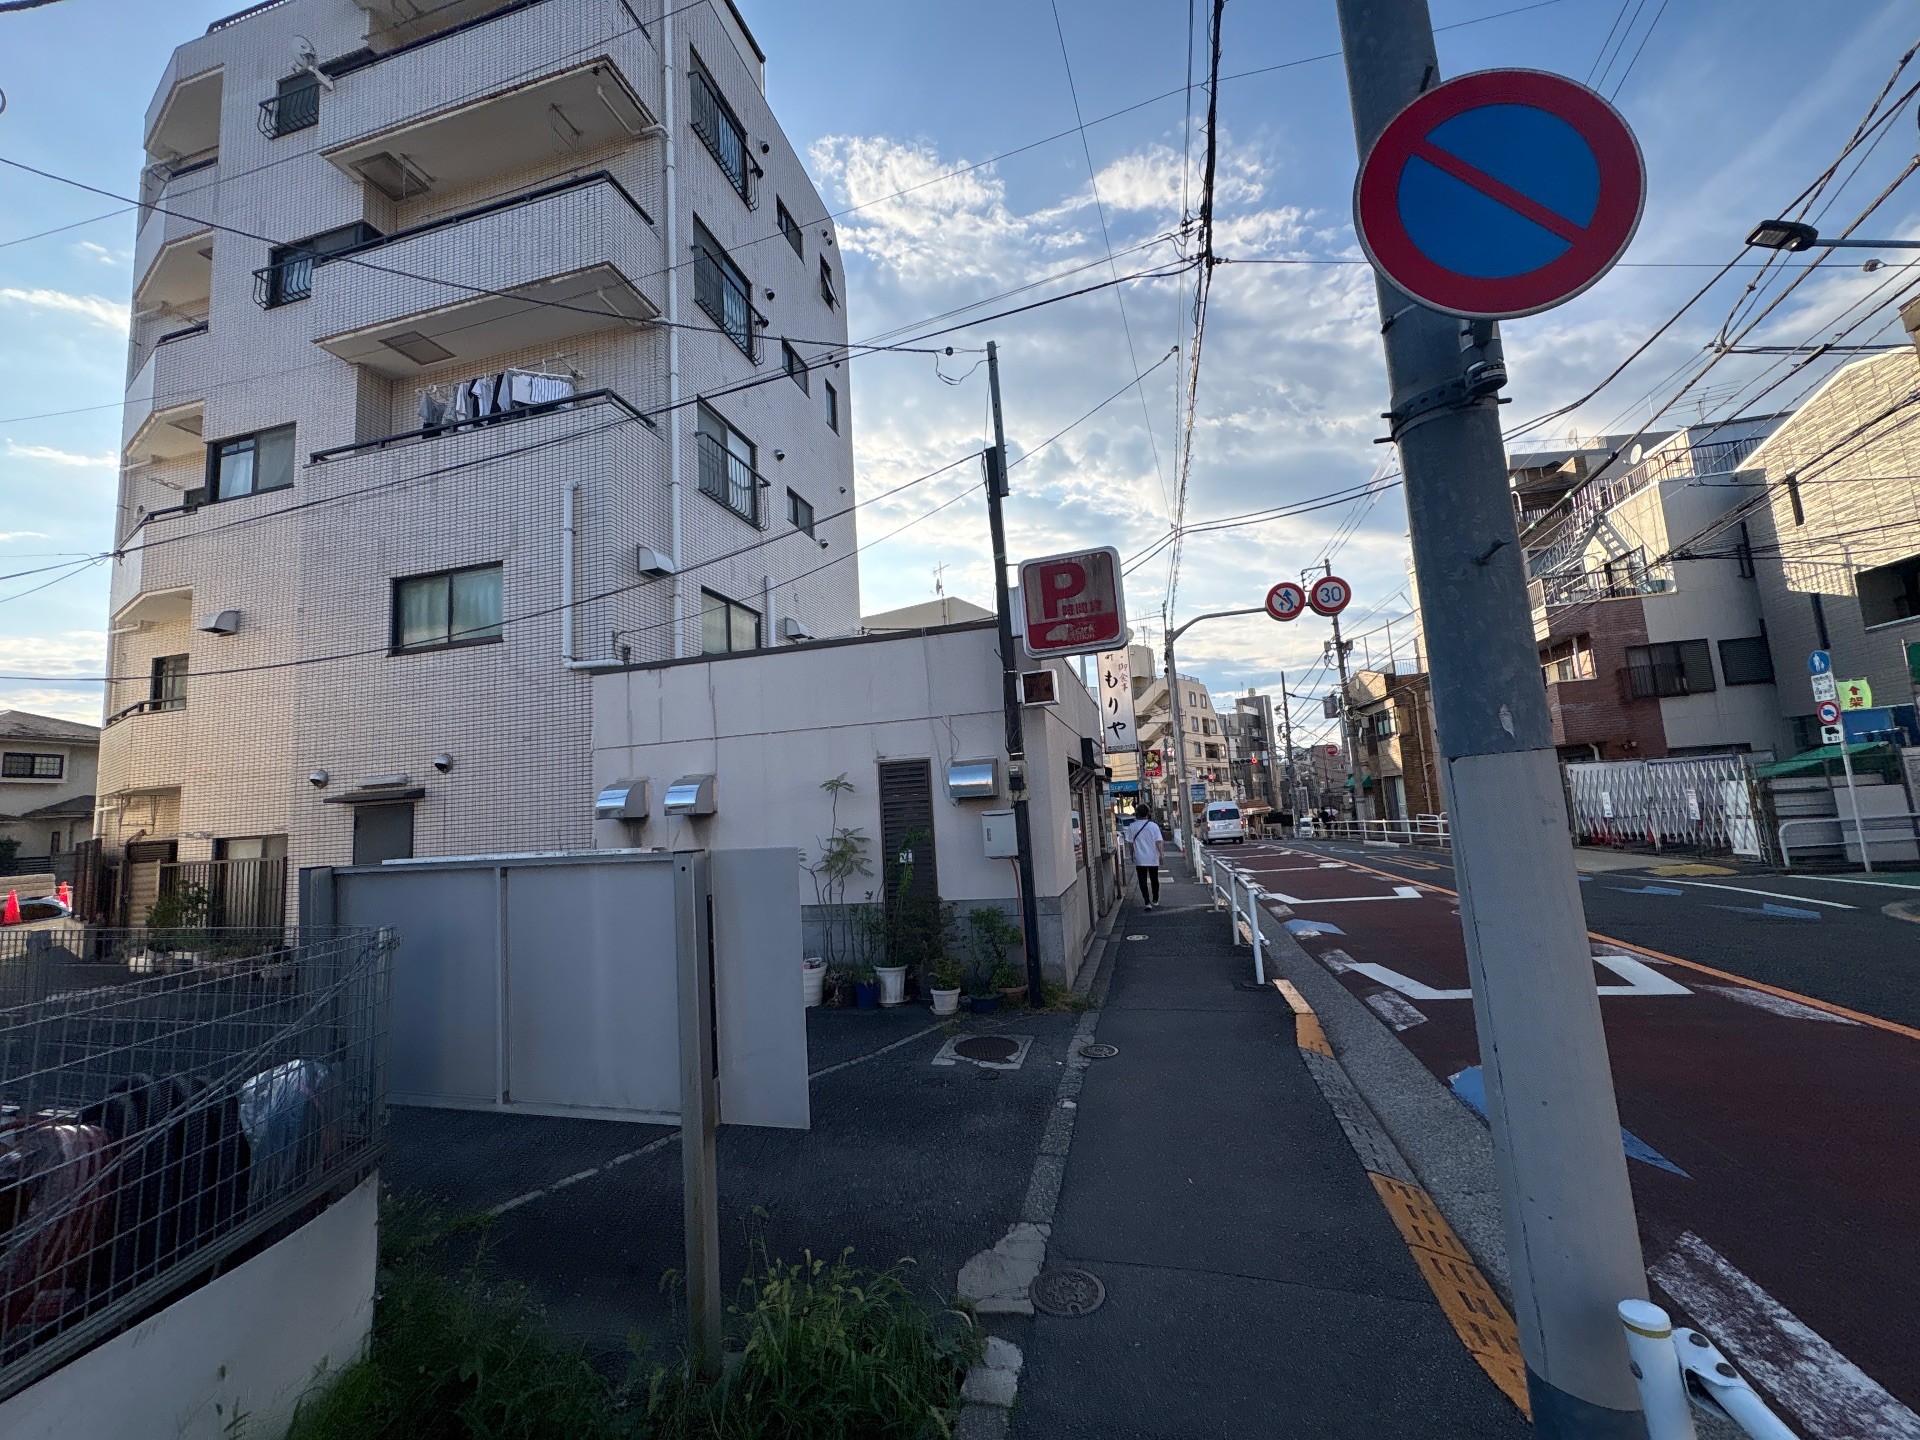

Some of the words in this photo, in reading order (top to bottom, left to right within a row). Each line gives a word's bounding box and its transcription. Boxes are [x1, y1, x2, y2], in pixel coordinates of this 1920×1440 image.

[1039, 563, 1086, 619] P
[1320, 587, 1341, 603] 30
[1105, 670, 1126, 740] もりや
[1849, 697, 1863, 707] 架
